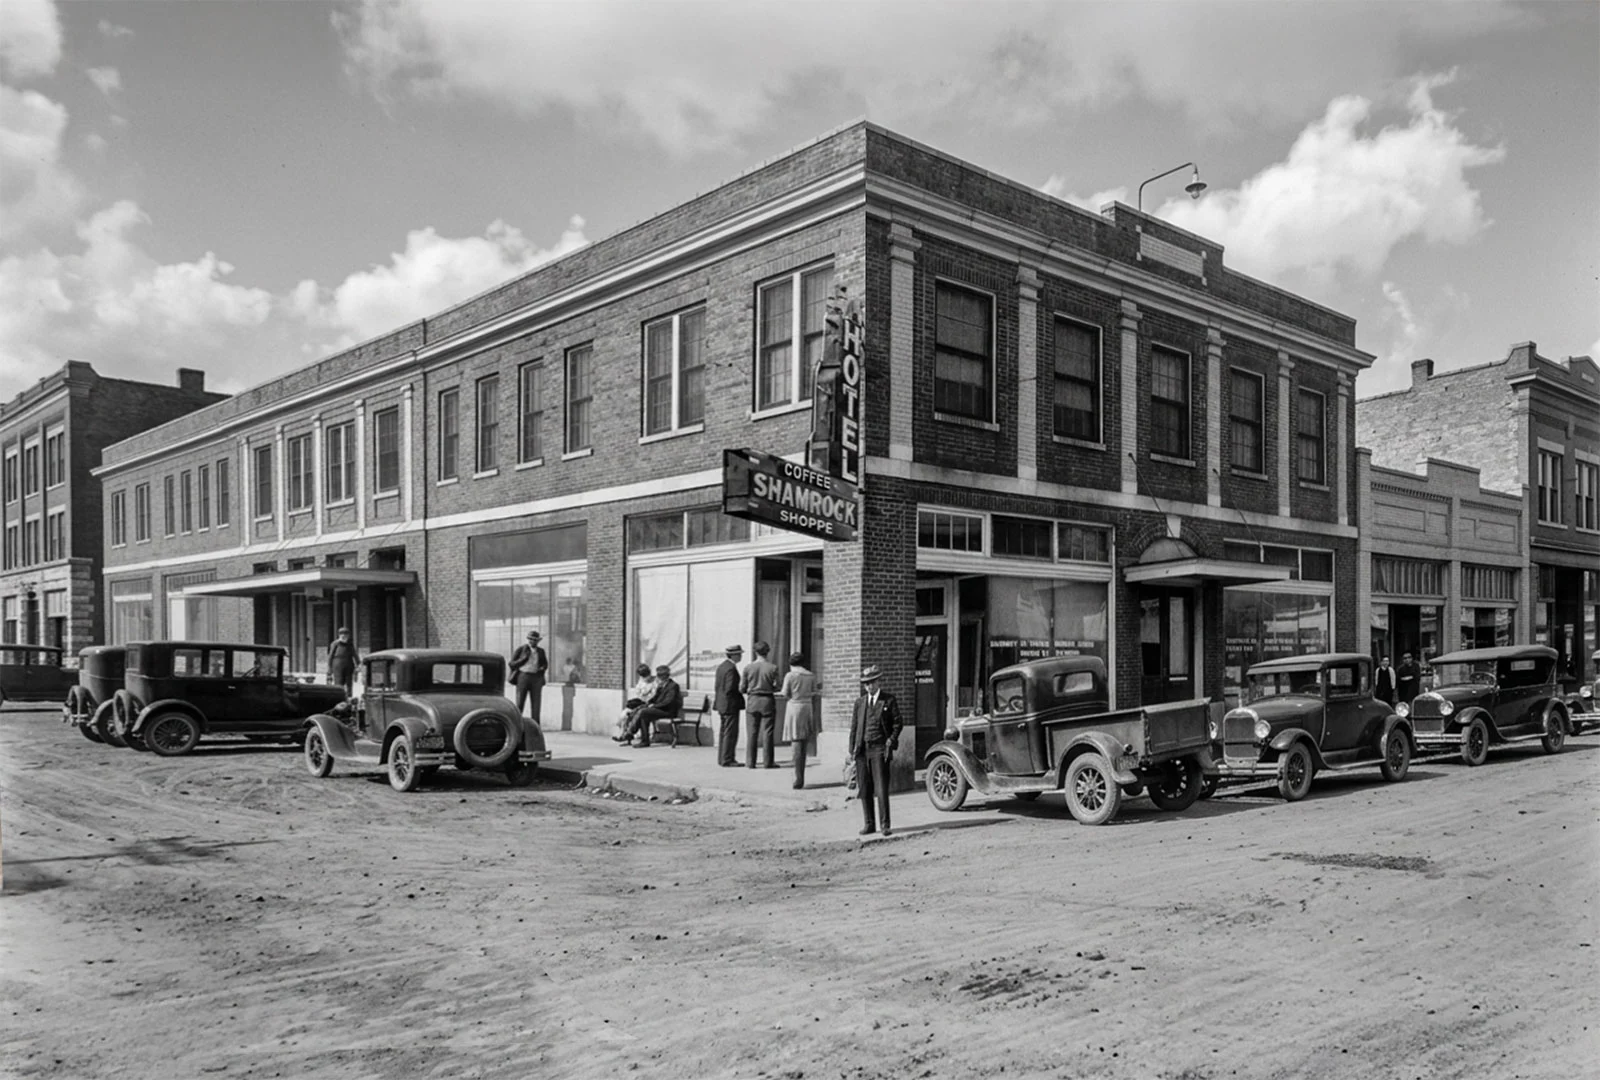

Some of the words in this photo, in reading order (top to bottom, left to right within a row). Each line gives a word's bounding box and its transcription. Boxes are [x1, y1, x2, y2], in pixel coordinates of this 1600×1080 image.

[842, 318, 860, 484] HOTEL
[784, 462, 831, 489] COFFEE
[753, 473, 856, 525] SHAMROCK
[780, 510, 833, 534] SHOPPE
